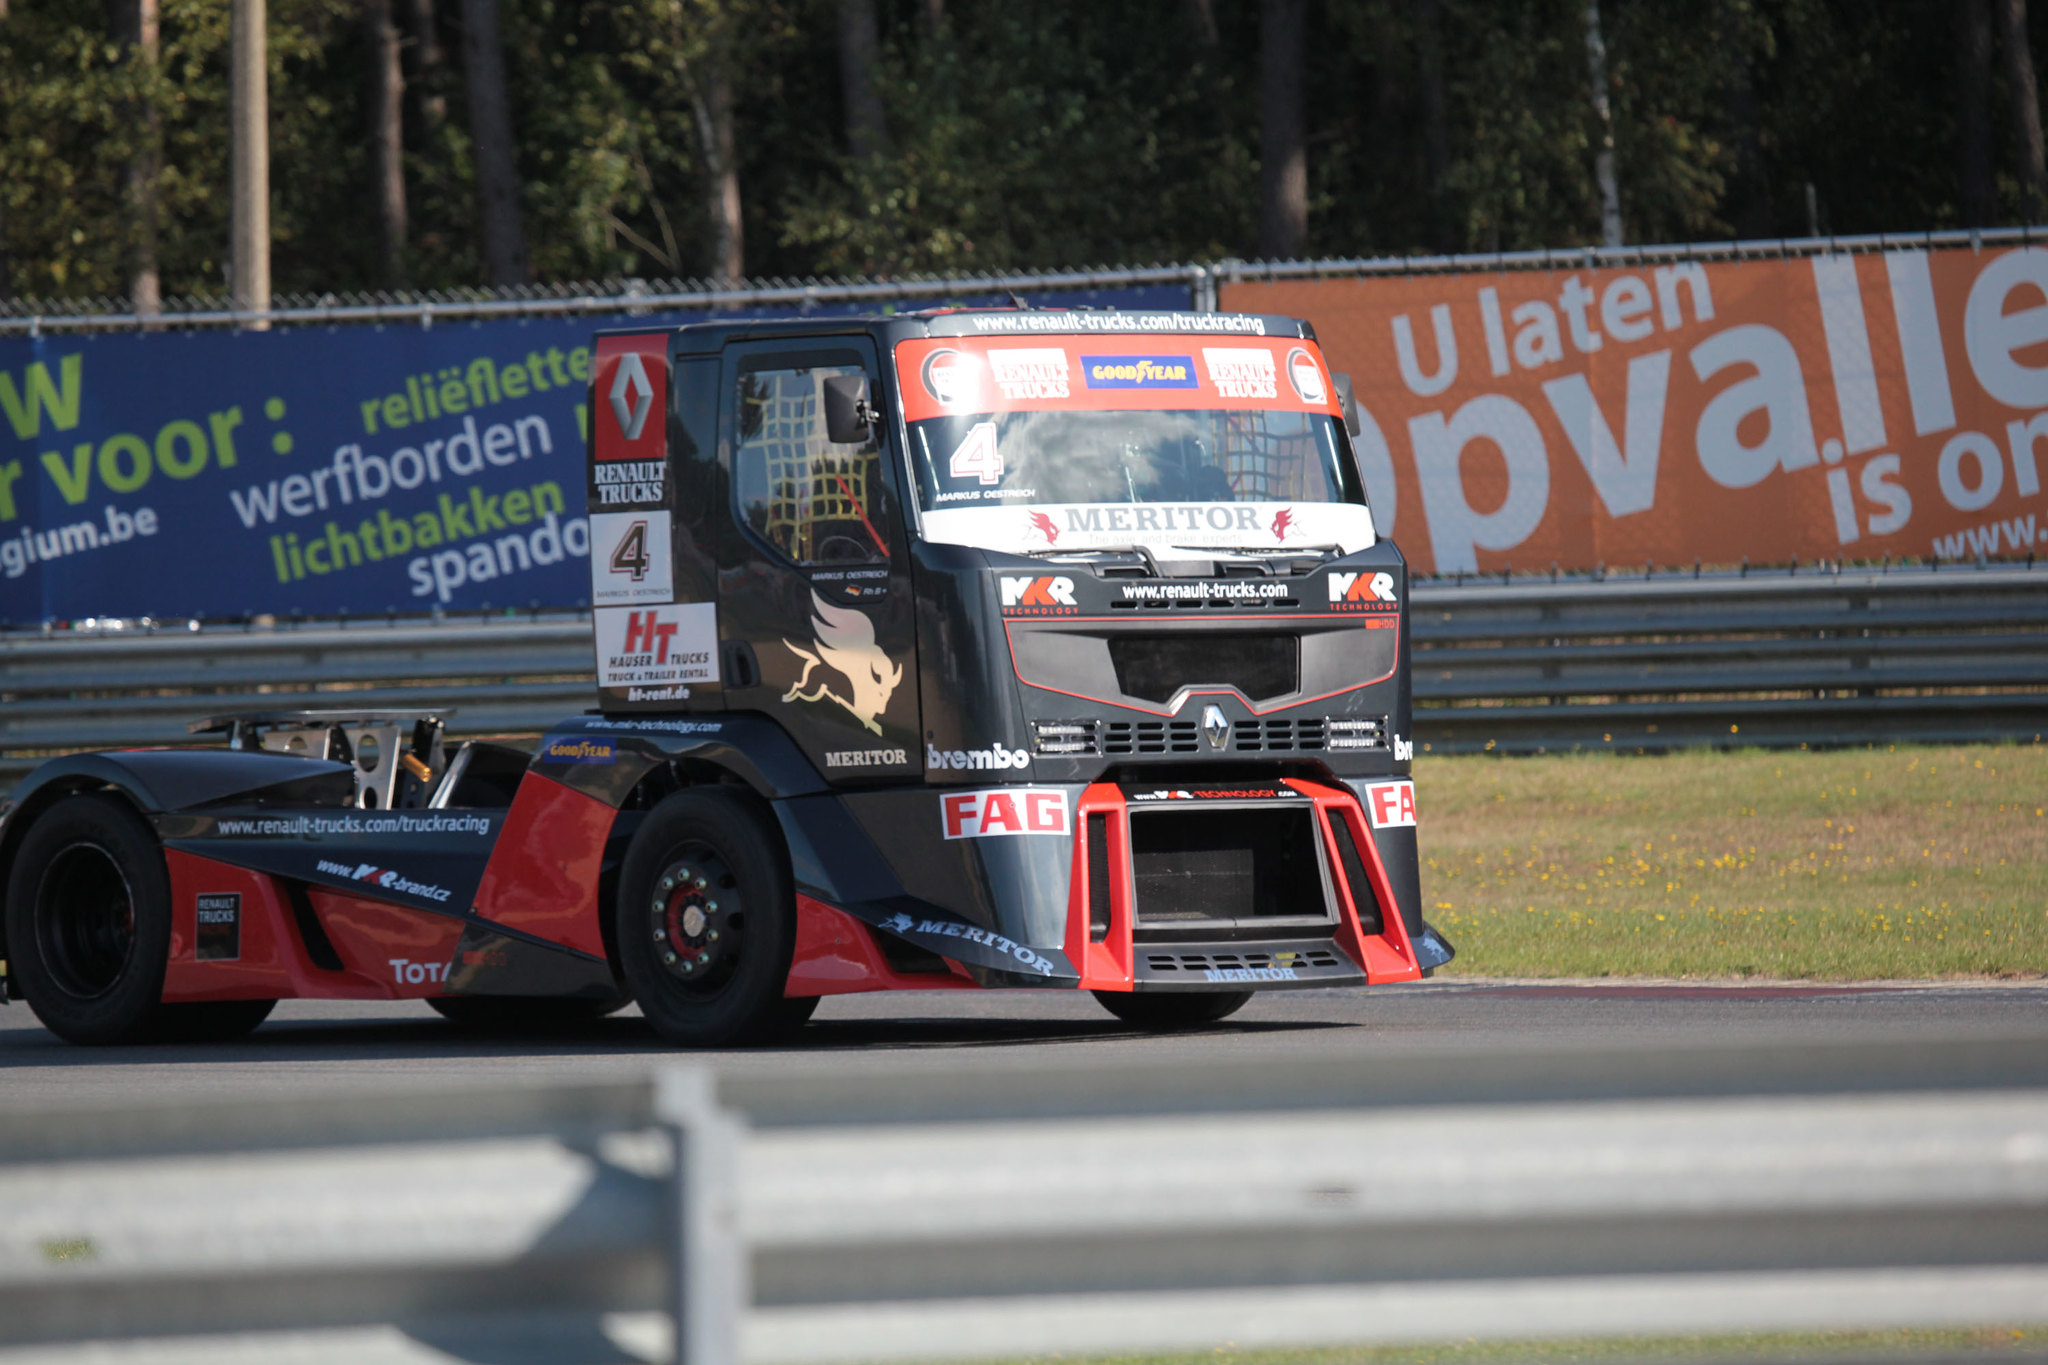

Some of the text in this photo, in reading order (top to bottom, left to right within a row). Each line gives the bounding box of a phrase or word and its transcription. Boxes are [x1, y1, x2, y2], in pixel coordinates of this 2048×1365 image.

[972, 311, 1266, 336] www.renault-trucks.com/truckracing
[1477, 260, 1715, 377] laten
[1092, 360, 1187, 384] GOODYEAR
[999, 381, 1070, 399] TRUCKS
[1213, 381, 1278, 399] TRUCKS
[40, 405, 244, 505] voor
[949, 422, 1005, 486] 4
[229, 415, 552, 529] werfborden
[594, 460, 667, 484] RENAULT
[597, 481, 664, 504] TRUCKS
[935, 489, 981, 502] MARKUS
[269, 481, 566, 583] lichtbakken
[1064, 506, 1262, 534] MERITOR
[609, 520, 651, 582] 4
[1000, 576, 1078, 606] MKR
[1122, 580, 1289, 599] www.renault-trucks.com
[1328, 572, 1397, 602] MKR
[1003, 607, 1079, 616] TECHNOLOGY
[1329, 603, 1398, 611] TECHNOLOGY
[609, 652, 709, 668] HAUSER TRUCKS
[608, 672, 635, 682] TRUCK
[644, 670, 676, 680] TRAILER
[549, 740, 612, 759] GOODYEAR
[825, 748, 907, 768] MERITOR
[927, 742, 1030, 770] brembo
[217, 814, 490, 836] www.renault-trucks.com/truckracing
[944, 793, 1065, 837] FAG
[198, 910, 235, 924] TRUCKS
[917, 919, 1056, 976] MERITOR
[1202, 967, 1299, 983] MERITOR
